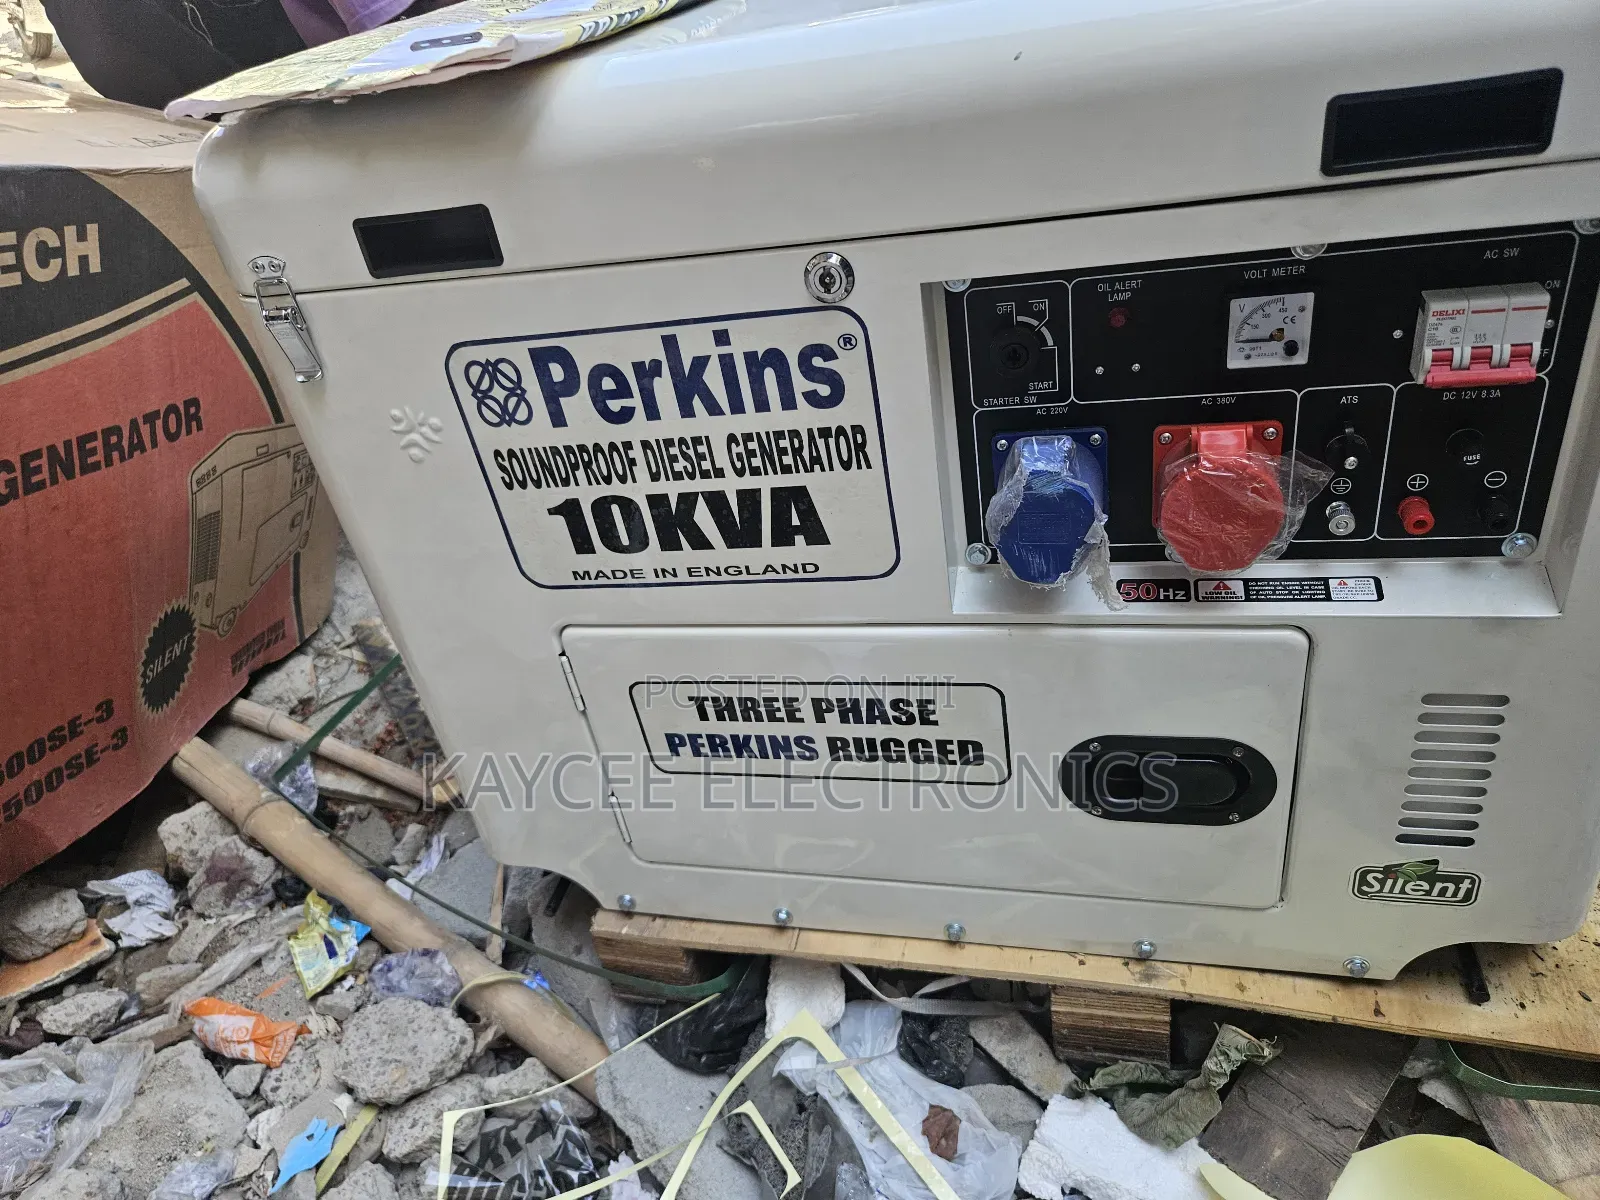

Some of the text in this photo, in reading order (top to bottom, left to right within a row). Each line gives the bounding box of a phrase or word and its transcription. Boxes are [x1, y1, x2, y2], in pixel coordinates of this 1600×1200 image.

[1484, 247, 1520, 260] AC SW
[1243, 265, 1307, 280] VOLT METER
[1097, 279, 1143, 292] OIL ALERT
[1544, 279, 1561, 290] ON
[1107, 291, 1132, 302] LAMP
[996, 304, 1013, 315] OFF
[1032, 302, 1046, 312] ON
[1238, 303, 1246, 313] V
[1431, 308, 1466, 318] DELIXI
[528, 328, 847, 429] Perkins
[1028, 381, 1054, 391] START
[983, 395, 1038, 406] STARTER SW
[1201, 395, 1237, 406] AC 380V
[1340, 395, 1359, 404] ATS
[1443, 389, 1501, 401] DC 12V 8.3A
[1036, 406, 1069, 416] AC 220V
[0, 396, 204, 507] GENERATOR
[1463, 453, 1481, 462] FUSE
[493, 424, 873, 492] SOUNDPROOF DIESEL GENERATOR
[547, 485, 832, 556] 10KVA
[572, 562, 821, 581] MADE IN ENGLAND
[145, 633, 191, 684] SILENT
[687, 696, 939, 726] THREE PHASE
[664, 733, 985, 767] PERKINS RUGGED
[1361, 871, 1472, 898] Silent
